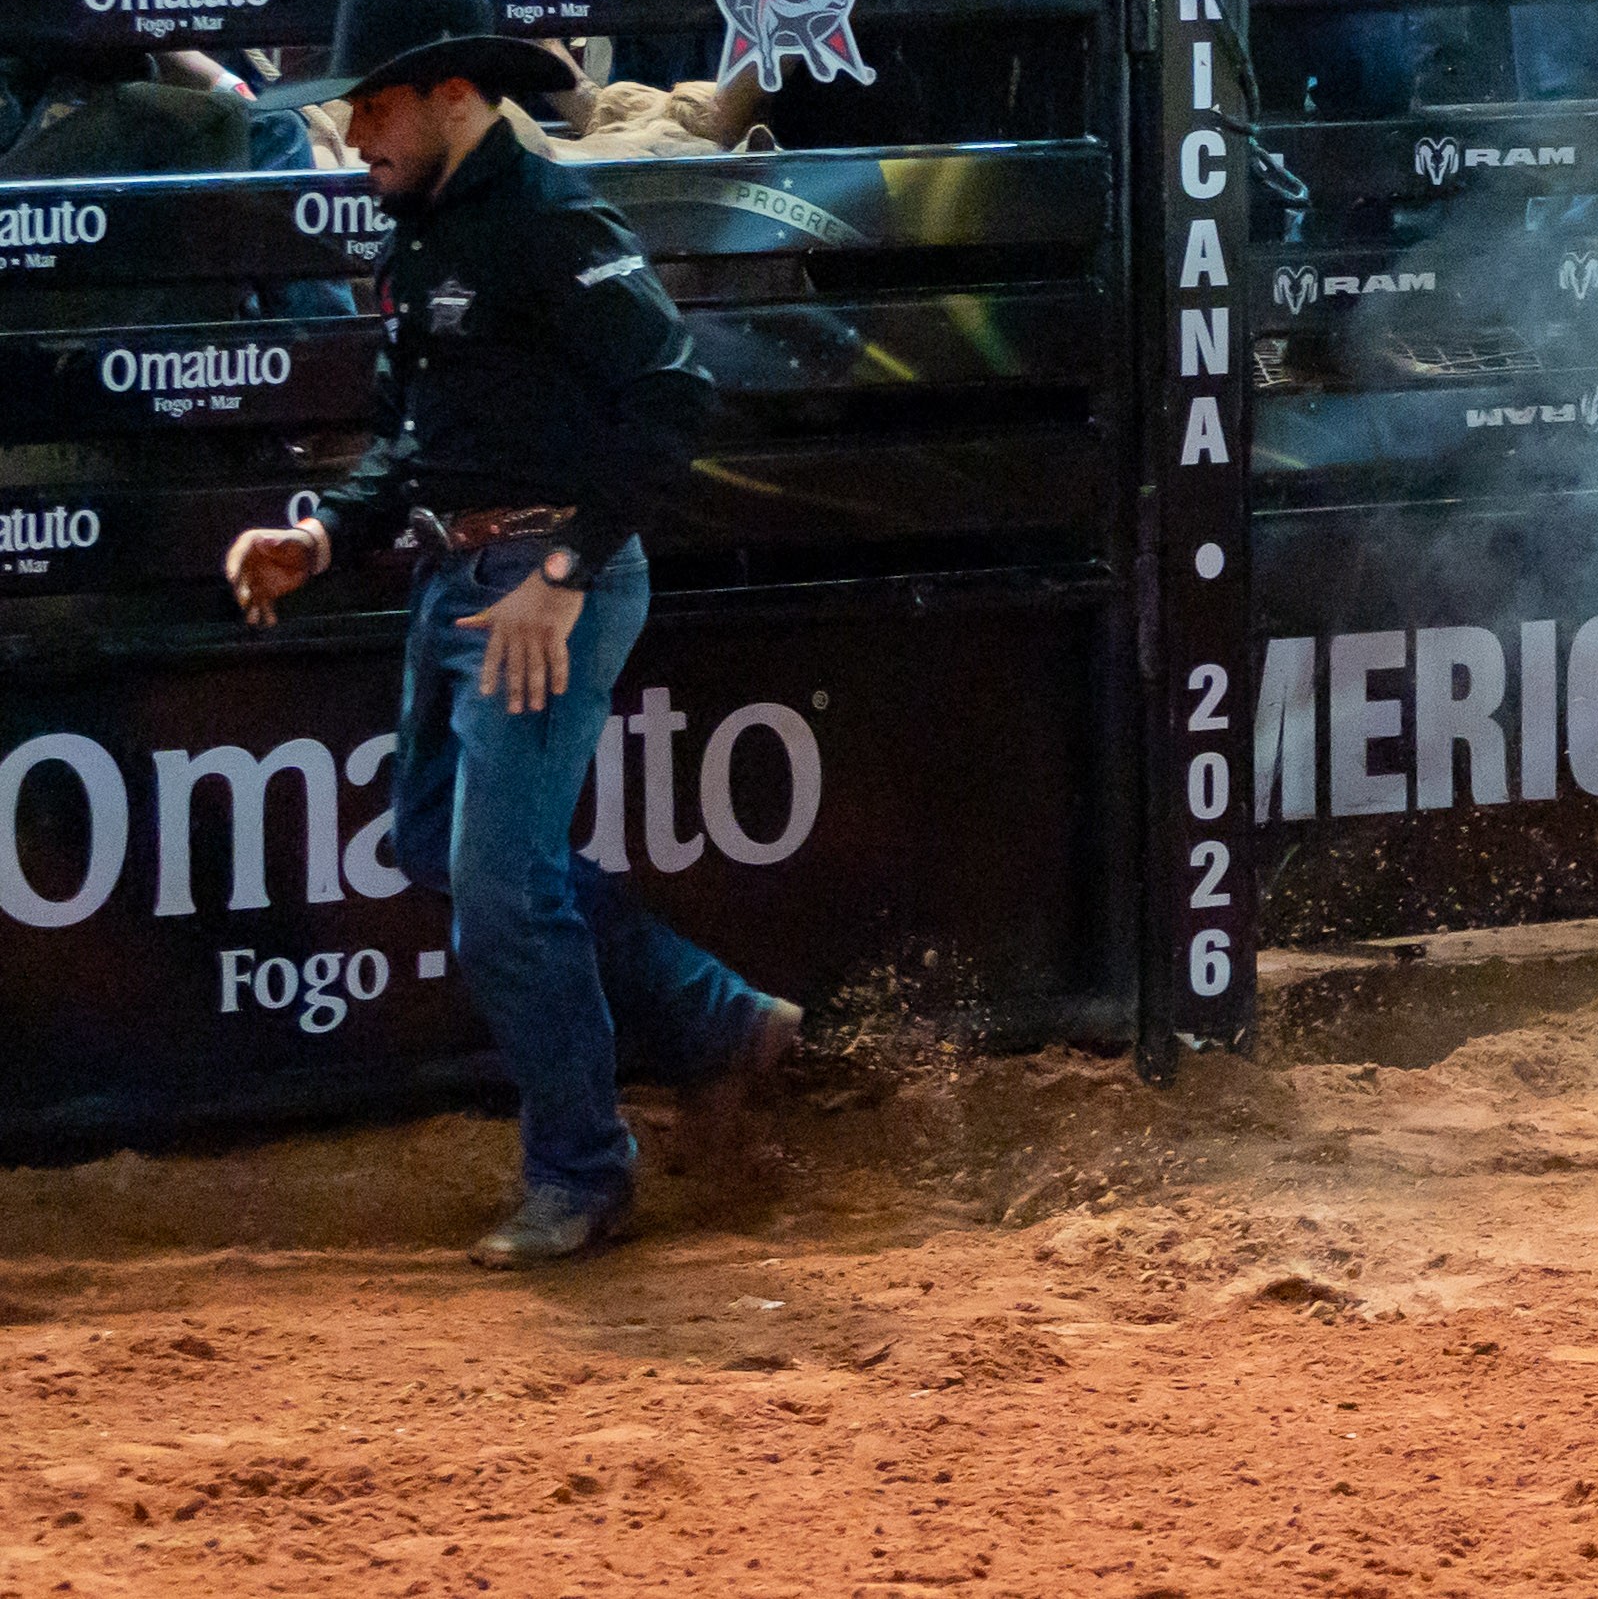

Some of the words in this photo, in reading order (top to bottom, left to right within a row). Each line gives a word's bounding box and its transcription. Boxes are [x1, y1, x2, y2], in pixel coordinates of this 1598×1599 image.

[135, 16, 176, 37] Fogo
[192, 15, 225, 31] Mar
[506, 2, 545, 23] Fogo
[550, 0, 590, 18] Mar
[1464, 146, 1576, 167] RAM
[0, 200, 107, 247] atuto
[1323, 272, 1436, 294] RAM
[102, 343, 291, 392] Omatuto
[153, 397, 193, 419] Fogo
[210, 395, 242, 411] Mar
[0, 505, 100, 552] atuto
[0, 686, 823, 928] Omato
[1187, 663, 1232, 997] 2026
[219, 948, 390, 1034] Fogo
